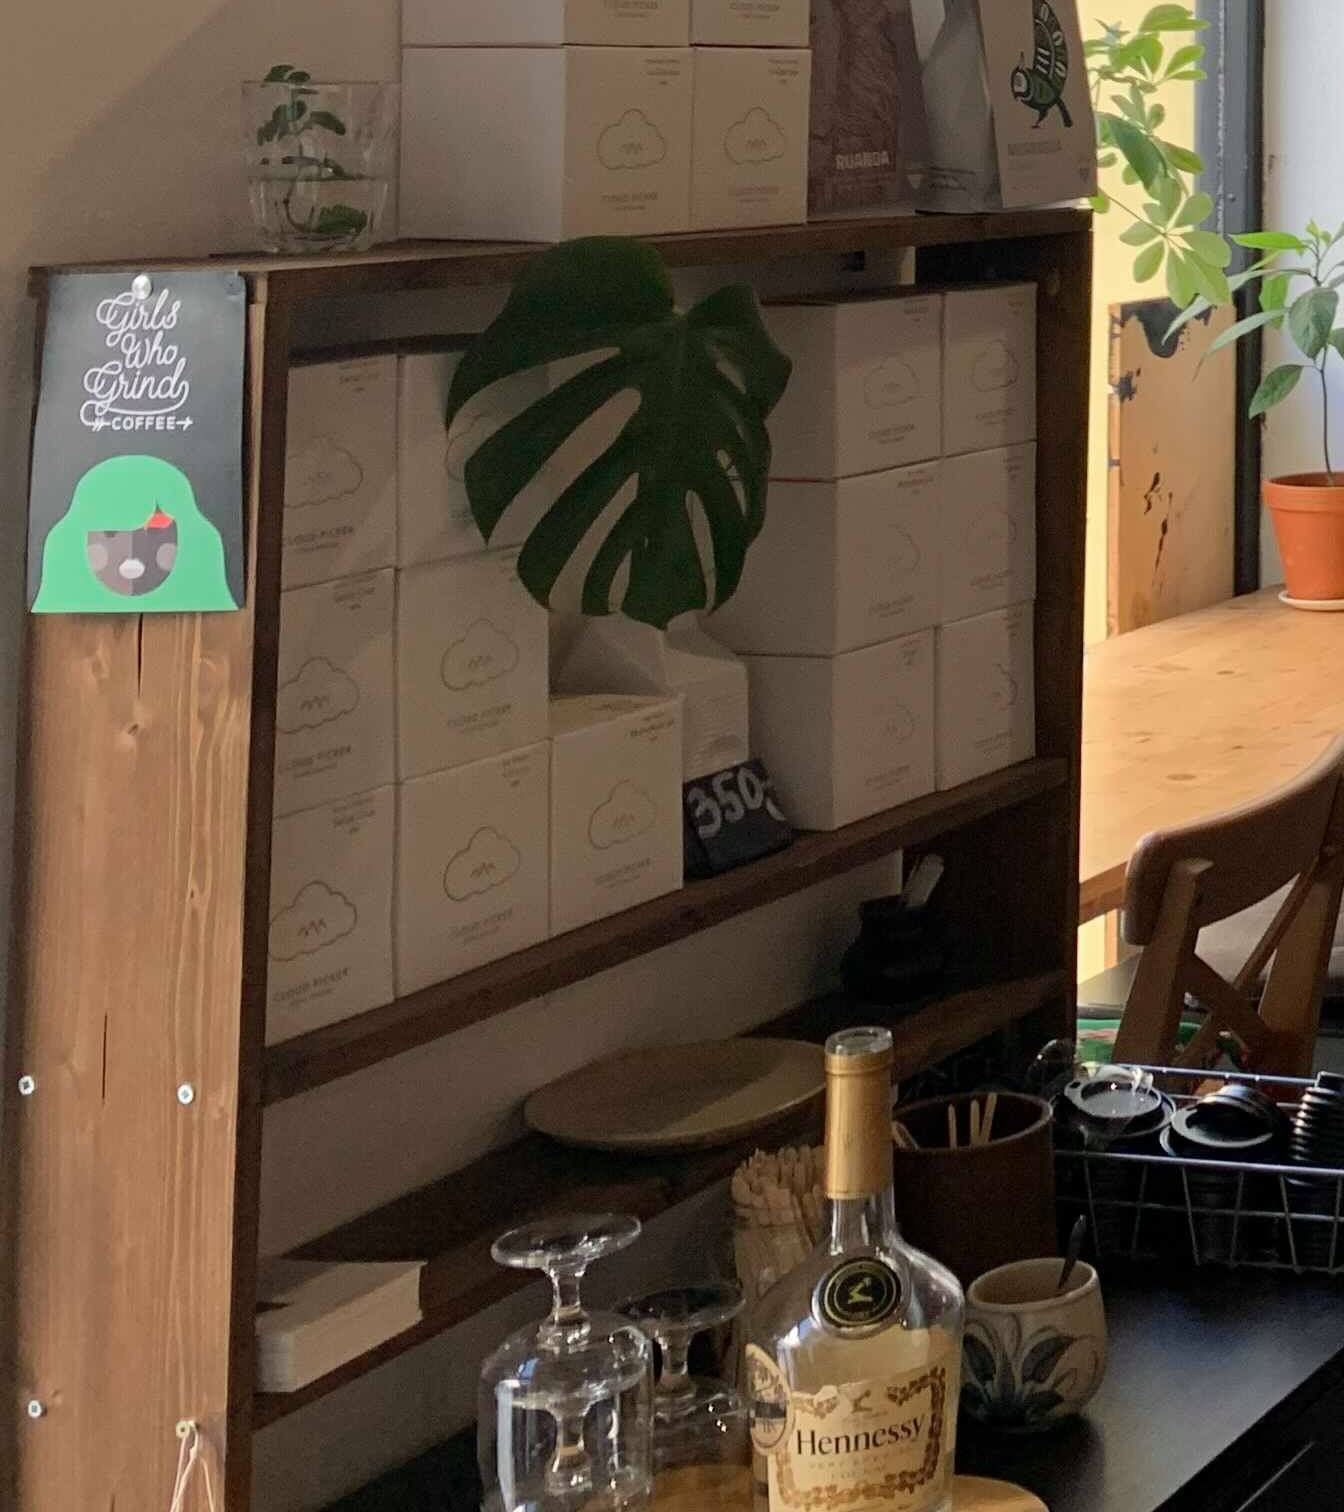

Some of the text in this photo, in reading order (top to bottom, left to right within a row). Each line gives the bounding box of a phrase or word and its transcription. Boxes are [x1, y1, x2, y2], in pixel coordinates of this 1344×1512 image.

[95, 288, 182, 347] Girls
[120, 330, 178, 369] Who
[82, 357, 191, 417] Grind
[110, 415, 177, 431] COFFEE
[796, 1414, 926, 1456] Hennessy
